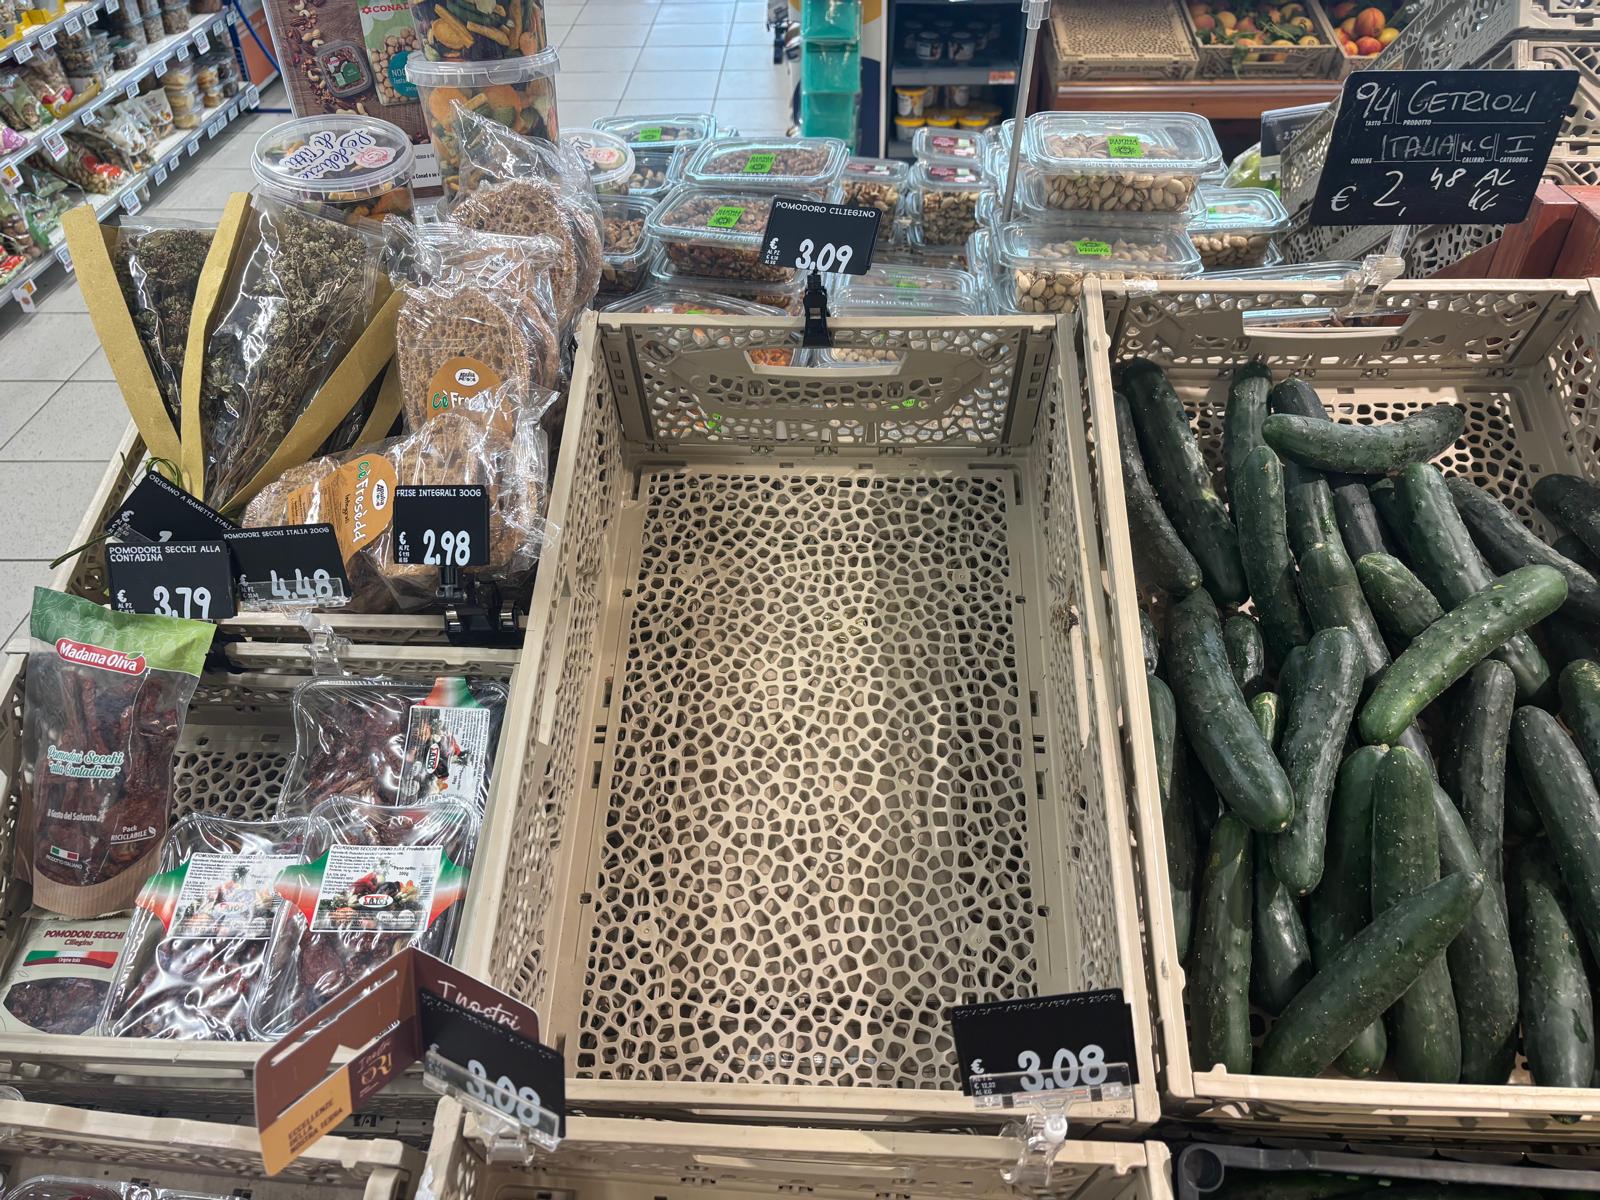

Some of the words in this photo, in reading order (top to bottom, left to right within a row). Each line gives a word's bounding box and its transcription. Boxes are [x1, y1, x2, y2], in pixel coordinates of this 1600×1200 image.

[1356, 82, 1398, 121] 94
[1380, 134, 1455, 162] ITALIA
[1461, 156, 1485, 164] CALIBRO
[1499, 156, 1529, 164] CATEGORIA
[1475, 168, 1516, 189] AL
[1330, 186, 1356, 212] €
[775, 201, 827, 213] POMODORO
[829, 207, 876, 218] CILIEGINO
[769, 237, 779, 250] €
[795, 238, 853, 274] 3.09
[148, 474, 180, 497] ORIGANO
[186, 498, 214, 519] RAMETTI
[396, 489, 416, 497] FRISE
[418, 488, 457, 497] INTEGRALI
[459, 488, 482, 497] 300G
[121, 510, 135, 522] €
[224, 532, 260, 540] POMODORI
[262, 530, 285, 538] SECCHI
[286, 527, 308, 536] ITALIA
[310, 526, 330, 534] 200G
[109, 546, 162, 554] POMODORI
[164, 545, 197, 553] SECCHI
[200, 545, 221, 553] ALLA
[399, 531, 407, 545] €
[422, 528, 471, 567] 2.98
[110, 553, 164, 562] CONTADINA
[270, 568, 333, 600] 4.48
[117, 589, 127, 603] €
[153, 585, 212, 619] 3.79
[59, 642, 106, 665] Madama
[106, 653, 138, 672] Oliva
[84, 750, 125, 766] Secchi
[110, 830, 148, 841] RICICLABILE
[122, 825, 138, 833] Pack
[44, 930, 93, 938] POMODORI
[93, 931, 125, 940] SECCHI
[64, 938, 94, 947] Ciliegino
[970, 1058, 985, 1074] €
[1017, 1043, 1108, 1092] 3.08
